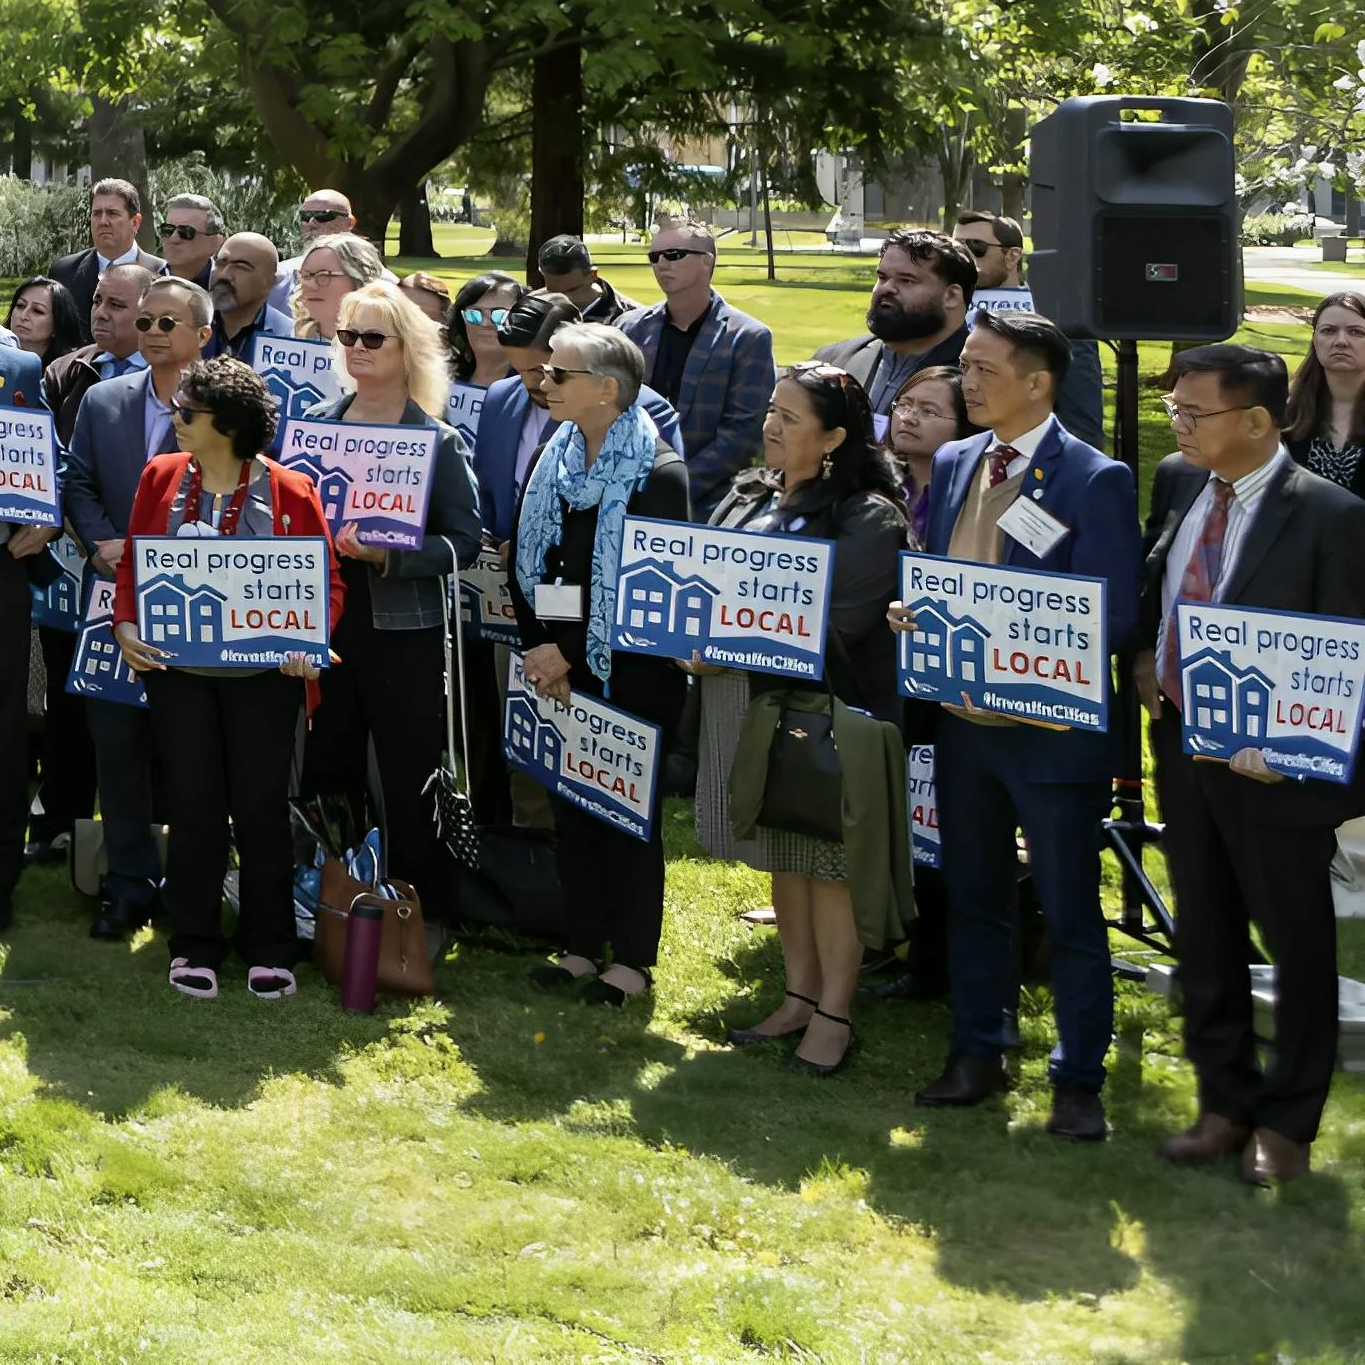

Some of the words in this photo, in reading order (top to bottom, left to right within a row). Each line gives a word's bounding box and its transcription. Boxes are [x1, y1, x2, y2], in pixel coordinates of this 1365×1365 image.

[262, 345, 306, 368] Real
[450, 393, 465, 410] al
[291, 428, 339, 451] Real
[343, 438, 427, 459] progress
[366, 464, 421, 485] starts
[351, 490, 416, 513] LOCAL
[145, 548, 198, 568] Real
[207, 553, 315, 574] progress
[633, 530, 693, 557] Real
[703, 542, 818, 573] progress
[243, 579, 315, 600] starts
[737, 576, 814, 605] starts
[911, 567, 963, 596] Real
[973, 582, 1090, 615] progress
[231, 609, 316, 630] LOCAL
[720, 605, 811, 637] LOCAL
[1008, 617, 1089, 650] starts
[1189, 616, 1246, 645] Real
[1257, 629, 1359, 660] progress
[993, 648, 1090, 685] LOCAL
[1291, 667, 1354, 698] starts
[1275, 700, 1346, 734] LOCAL
[580, 736, 643, 777] starts
[567, 752, 641, 804] LOCAL
